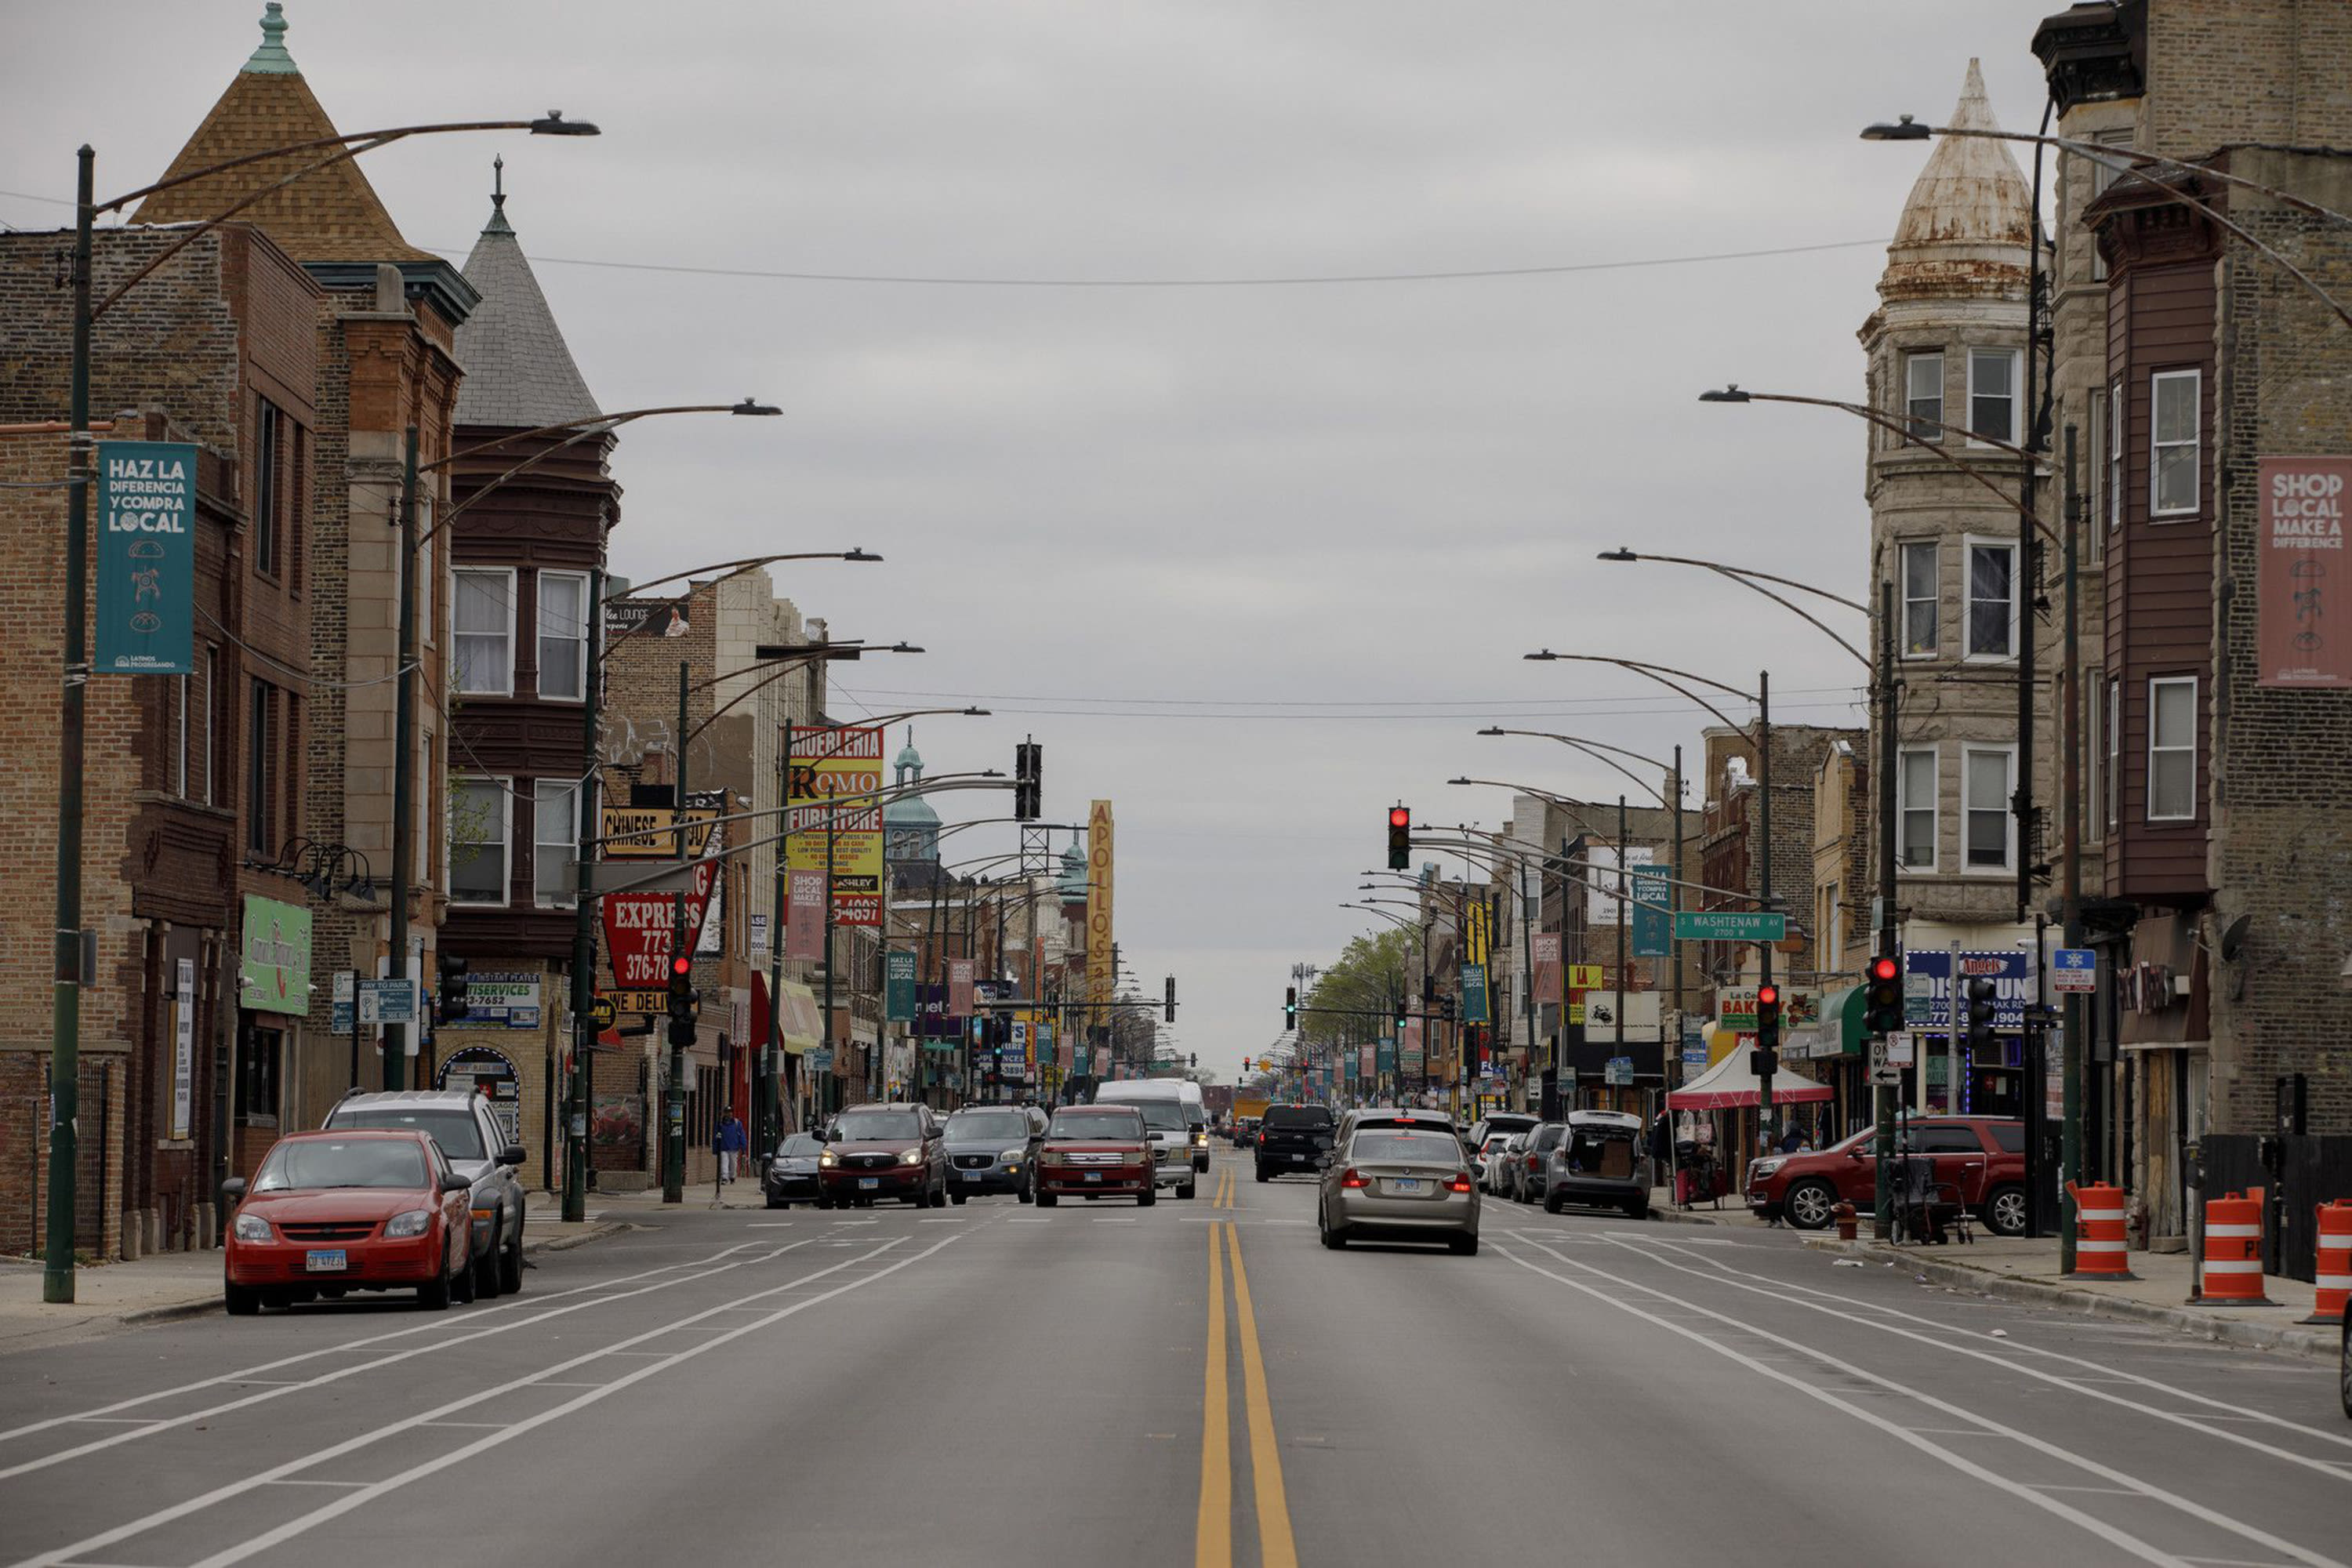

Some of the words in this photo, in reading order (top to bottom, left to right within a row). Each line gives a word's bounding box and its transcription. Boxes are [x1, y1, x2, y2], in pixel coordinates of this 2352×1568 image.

[109, 459, 153, 479] HAZ
[159, 460, 185, 480] LA
[110, 481, 185, 494] DIFERENCIA
[2272, 474, 2343, 498] SHOP
[110, 495, 120, 509] Y
[122, 496, 184, 511] COMPRA
[2273, 499, 2343, 518] LOCAL
[109, 512, 185, 533] LOCAL
[2274, 519, 2325, 535] MAKE
[2329, 519, 2343, 535] A
[2272, 537, 2343, 550] DIFFERENCE
[790, 731, 880, 757] MUEBLERIA
[789, 765, 877, 798] ROMO
[789, 808, 879, 830] FURNITURE
[605, 815, 656, 845] CHINESE
[671, 815, 703, 846] FOD
[793, 876, 822, 886] SHOP
[1637, 871, 1653, 880] HAZ
[1655, 871, 1667, 880] LA
[1637, 892, 1667, 901] LOCAL
[1694, 916, 1761, 927] WASHTENAW
[641, 930, 672, 953] 773
[626, 954, 670, 981] 376-78
[1964, 957, 2000, 975] Angels
[1577, 967, 1588, 985] LA
[1930, 978, 2027, 1000] DISCUN
[609, 993, 629, 1010] WE
[637, 993, 670, 1011] DELI
[916, 1000, 949, 1012] met
[1722, 1000, 1787, 1014] BAKY
[1874, 1045, 1888, 1054] ON
[1874, 1058, 1889, 1066] WA
